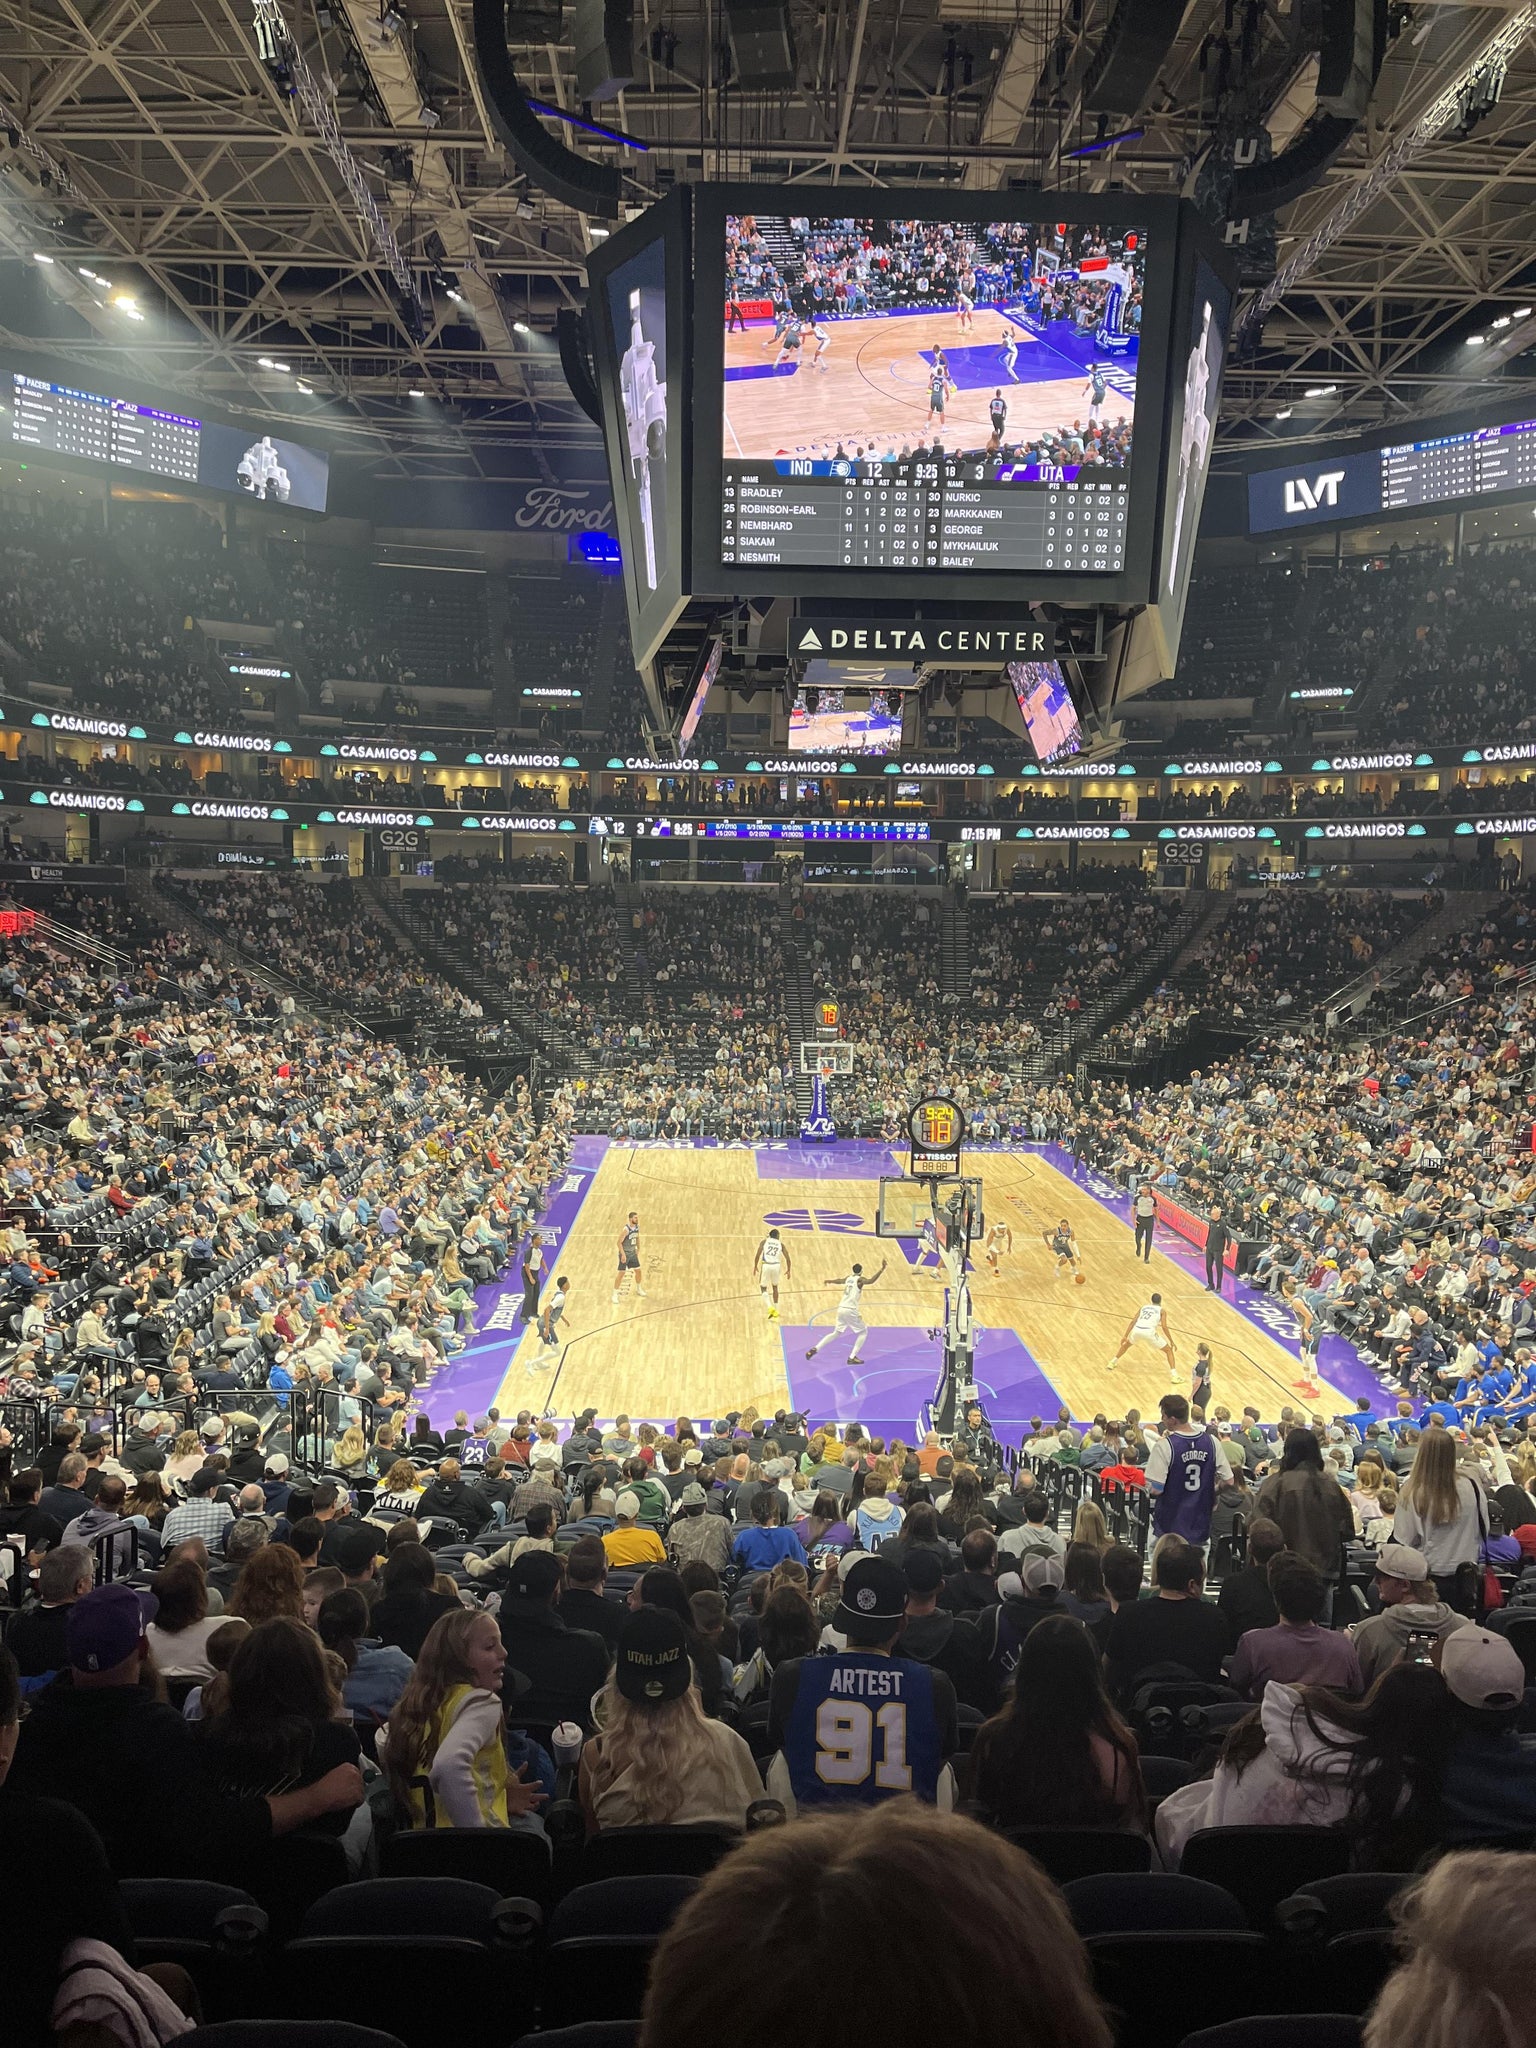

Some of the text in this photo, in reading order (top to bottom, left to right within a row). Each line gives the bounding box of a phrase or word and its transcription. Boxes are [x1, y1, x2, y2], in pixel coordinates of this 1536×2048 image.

[27, 378, 51, 391] PACERS
[123, 402, 138, 412] JAZZ
[1486, 428, 1501, 437] JAZZ
[796, 440, 858, 452] DELTA
[1393, 445, 1414, 455] PACERS
[791, 460, 812, 475] IND
[868, 464, 882, 477] 12
[916, 464, 937, 479] 9:25
[945, 466, 955, 476] 18
[976, 465, 984, 479] 3
[1040, 467, 1064, 481] UTA
[724, 488, 1125, 505] 13 BRADLEY 0 0 0 02 1 30 NURKIC 0 0 0 02 0
[1284, 471, 1346, 513] LVT
[515, 488, 613, 529] Ford
[723, 504, 735, 513] 25
[741, 505, 816, 515] ROBINSON-EARL
[846, 507, 852, 515] 0
[880, 508, 886, 516] 2
[895, 508, 906, 517] 02
[914, 509, 920, 517] 0
[928, 509, 939, 517] 23
[945, 509, 1002, 519] MARKKANEN
[1050, 512, 1056, 520] 3
[1068, 512, 1074, 520] 0
[1084, 512, 1091, 520] 0
[1098, 513, 1109, 521] 02
[1117, 513, 1124, 521] 0
[726, 520, 732, 529] 2
[740, 521, 793, 530] NEMBHARD
[864, 524, 868, 532] 1
[879, 524, 886, 532] 0
[894, 525, 906, 533] 02
[914, 525, 918, 533] 1
[930, 525, 936, 534] 3
[945, 526, 983, 534] GEORGE
[1049, 528, 1055, 536] 0
[1067, 528, 1073, 536] 0
[1084, 528, 1089, 536] 1
[1097, 529, 1108, 537] 02
[1117, 529, 1121, 537] 1
[723, 536, 735, 545] 43
[740, 537, 775, 546] SIAKAM
[845, 539, 851, 547] 2
[864, 540, 868, 548] 1
[894, 541, 905, 549] 02
[912, 541, 919, 549] 0
[927, 541, 937, 549] 10
[943, 542, 999, 551] MYKHAILIUK
[1048, 544, 1054, 552] 0
[1066, 544, 1072, 552] 0
[1115, 545, 1121, 553] 0
[723, 552, 1120, 569] 23 NESMITH 0 1 1 02 0 19 BAILEY 0 0 0 02 0
[831, 629, 1044, 651] DELTA CENTER
[240, 665, 280, 677] CASAMIGOS
[532, 688, 571, 696] CASAMIGOS
[1301, 688, 1343, 697] CASAMIGOS
[51, 715, 126, 737] CASAMIGOS
[194, 733, 271, 751] CASAMIGOS
[340, 745, 417, 762] CASAMIGOS
[1484, 744, 1536, 761] CASAMI
[485, 753, 560, 768] CASAMIGOS
[764, 760, 837, 774] CASAMIGOS
[1184, 760, 1262, 775] CASAMIGOS
[1332, 754, 1412, 770] CASAMIGOS
[903, 763, 976, 776] CASAMIGOS
[50, 792, 124, 811] CASAMIGOS
[192, 803, 268, 819] CASAMIGOS
[337, 811, 413, 826] CASAMIGOS
[482, 817, 556, 830] CASAMIGOS
[613, 822, 644, 834] 12 3
[674, 823, 692, 835] 9:25
[1325, 823, 1405, 837] CASAMIGOS
[1476, 817, 1536, 834] CASAMIG
[380, 830, 419, 846] G2G
[962, 828, 1000, 840] 07:15 PM
[1035, 827, 1109, 839] CASAMIGOS
[1178, 826, 1256, 838] CASAMIGOS
[1164, 843, 1203, 857] G2G
[927, 1108, 954, 1120] 9:24
[931, 1121, 950, 1142] 18
[609, 1141, 788, 1150] UTAH JAZZ
[464, 1447, 484, 1463] 23
[1181, 1451, 1208, 1462] GEORGE
[1184, 1464, 1201, 1491] 3
[626, 1647, 680, 1666] UTAH JAZZ
[829, 1668, 904, 1696] ARTEST
[815, 1698, 912, 1790] 91
